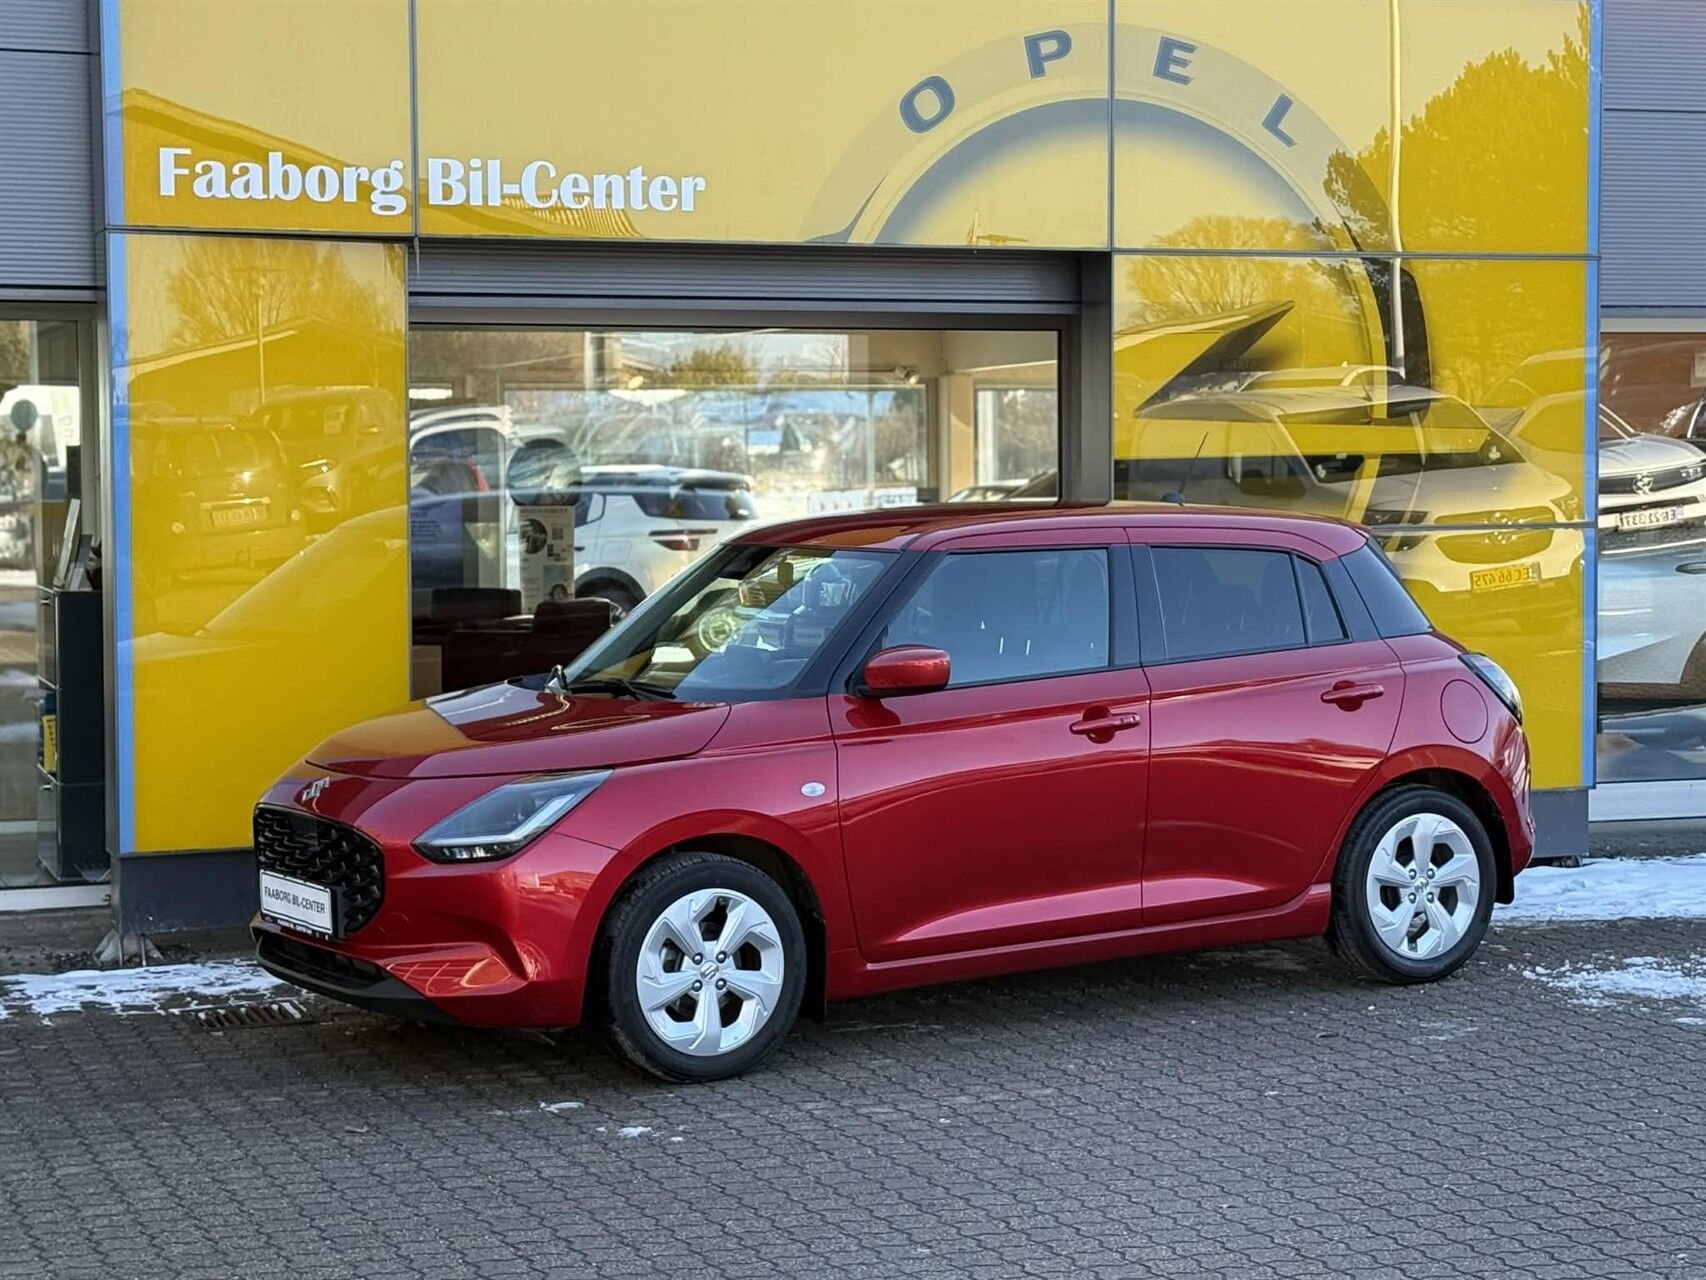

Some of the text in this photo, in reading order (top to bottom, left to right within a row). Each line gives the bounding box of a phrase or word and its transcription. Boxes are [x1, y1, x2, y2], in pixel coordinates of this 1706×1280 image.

[898, 29, 1301, 148] OPEL
[158, 147, 706, 216] Faaborg Bil-Center
[264, 886, 326, 914] FAABORG BIL-CENTER
